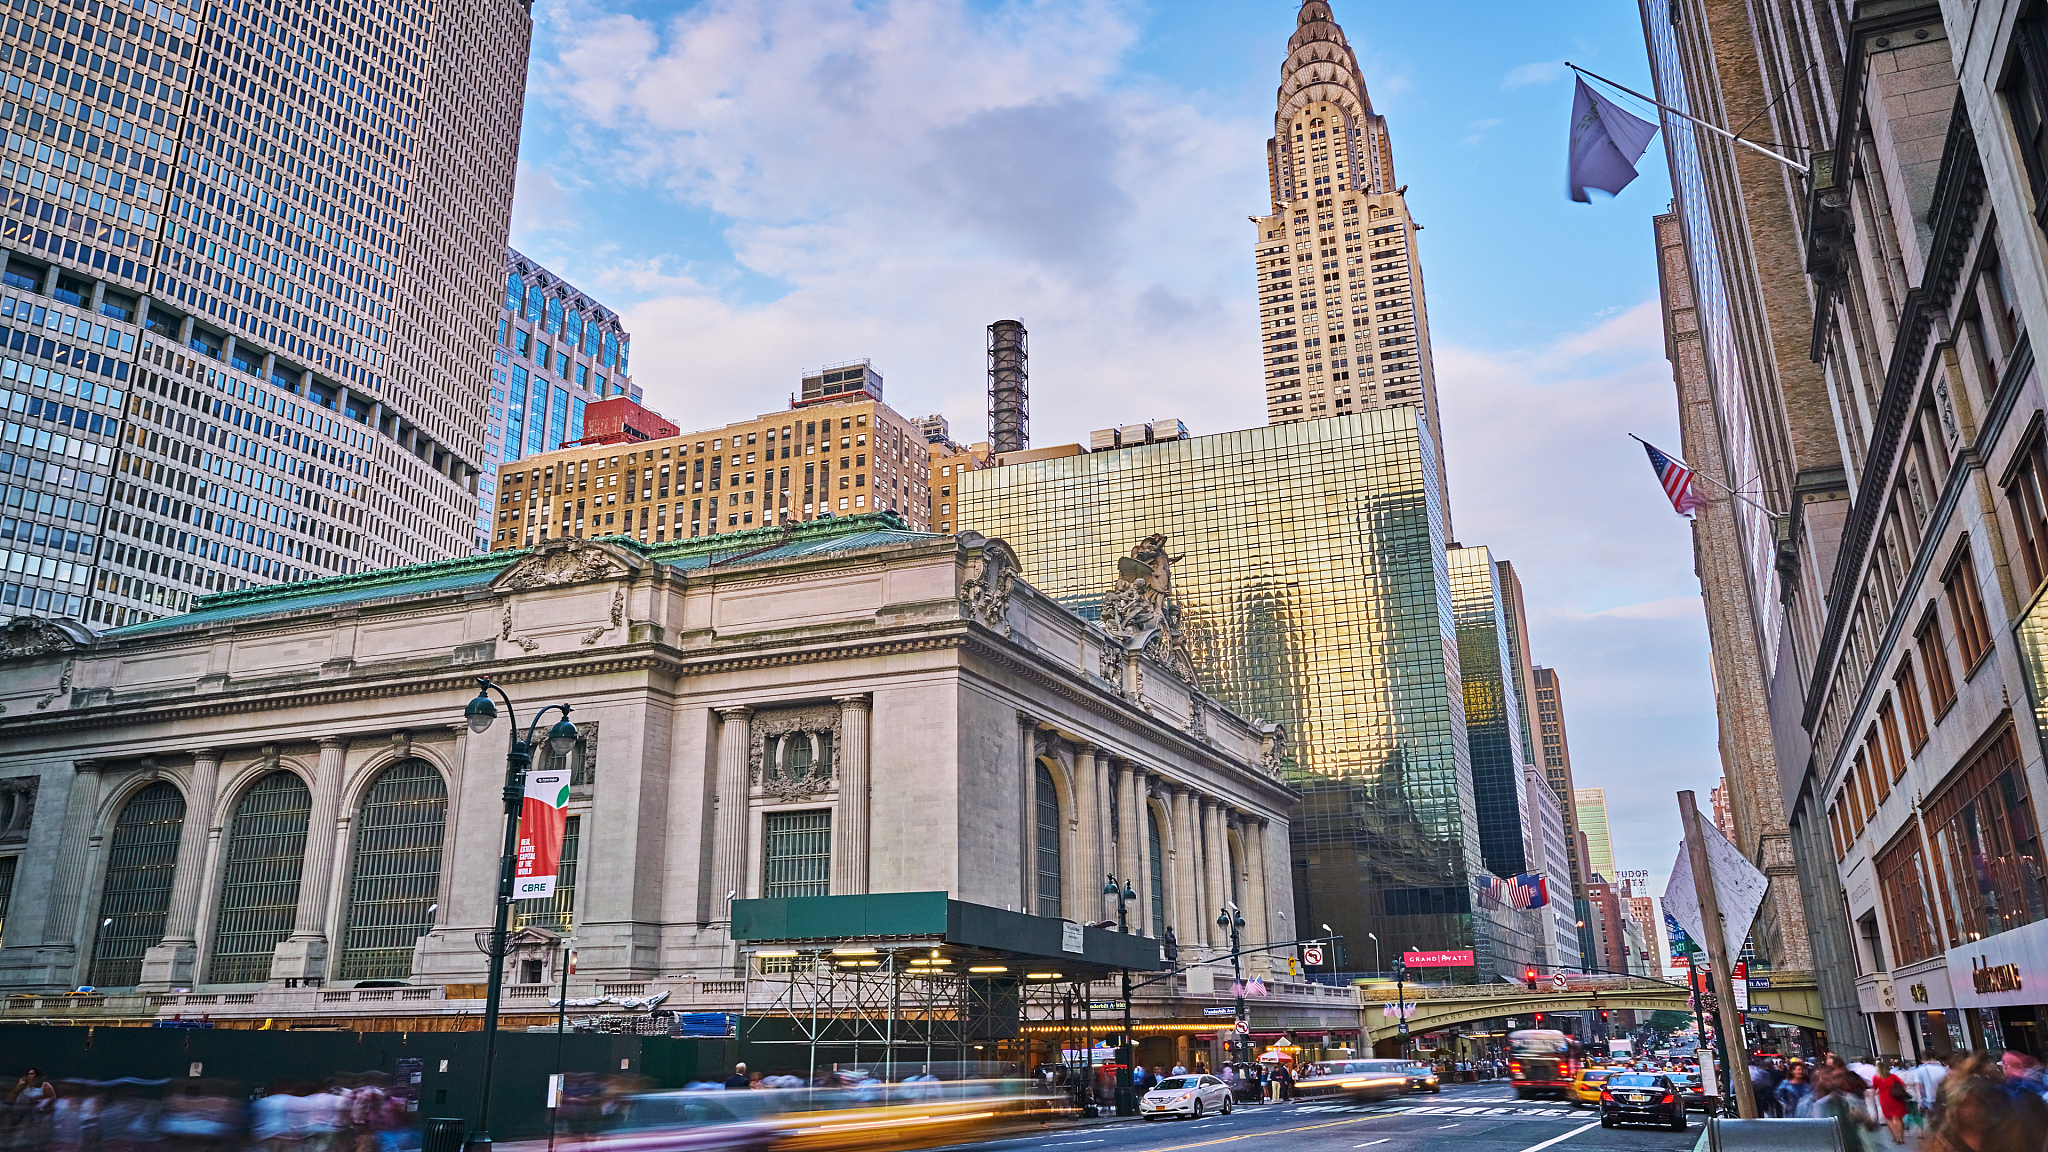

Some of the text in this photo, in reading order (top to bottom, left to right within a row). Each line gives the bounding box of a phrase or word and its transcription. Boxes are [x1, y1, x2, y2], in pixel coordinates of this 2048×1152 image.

[1615, 869, 1649, 878] TUDOR
[521, 882, 546, 892] CBRE
[1430, 1001, 1569, 1024] GRAND CENTRAL TERMINAL
